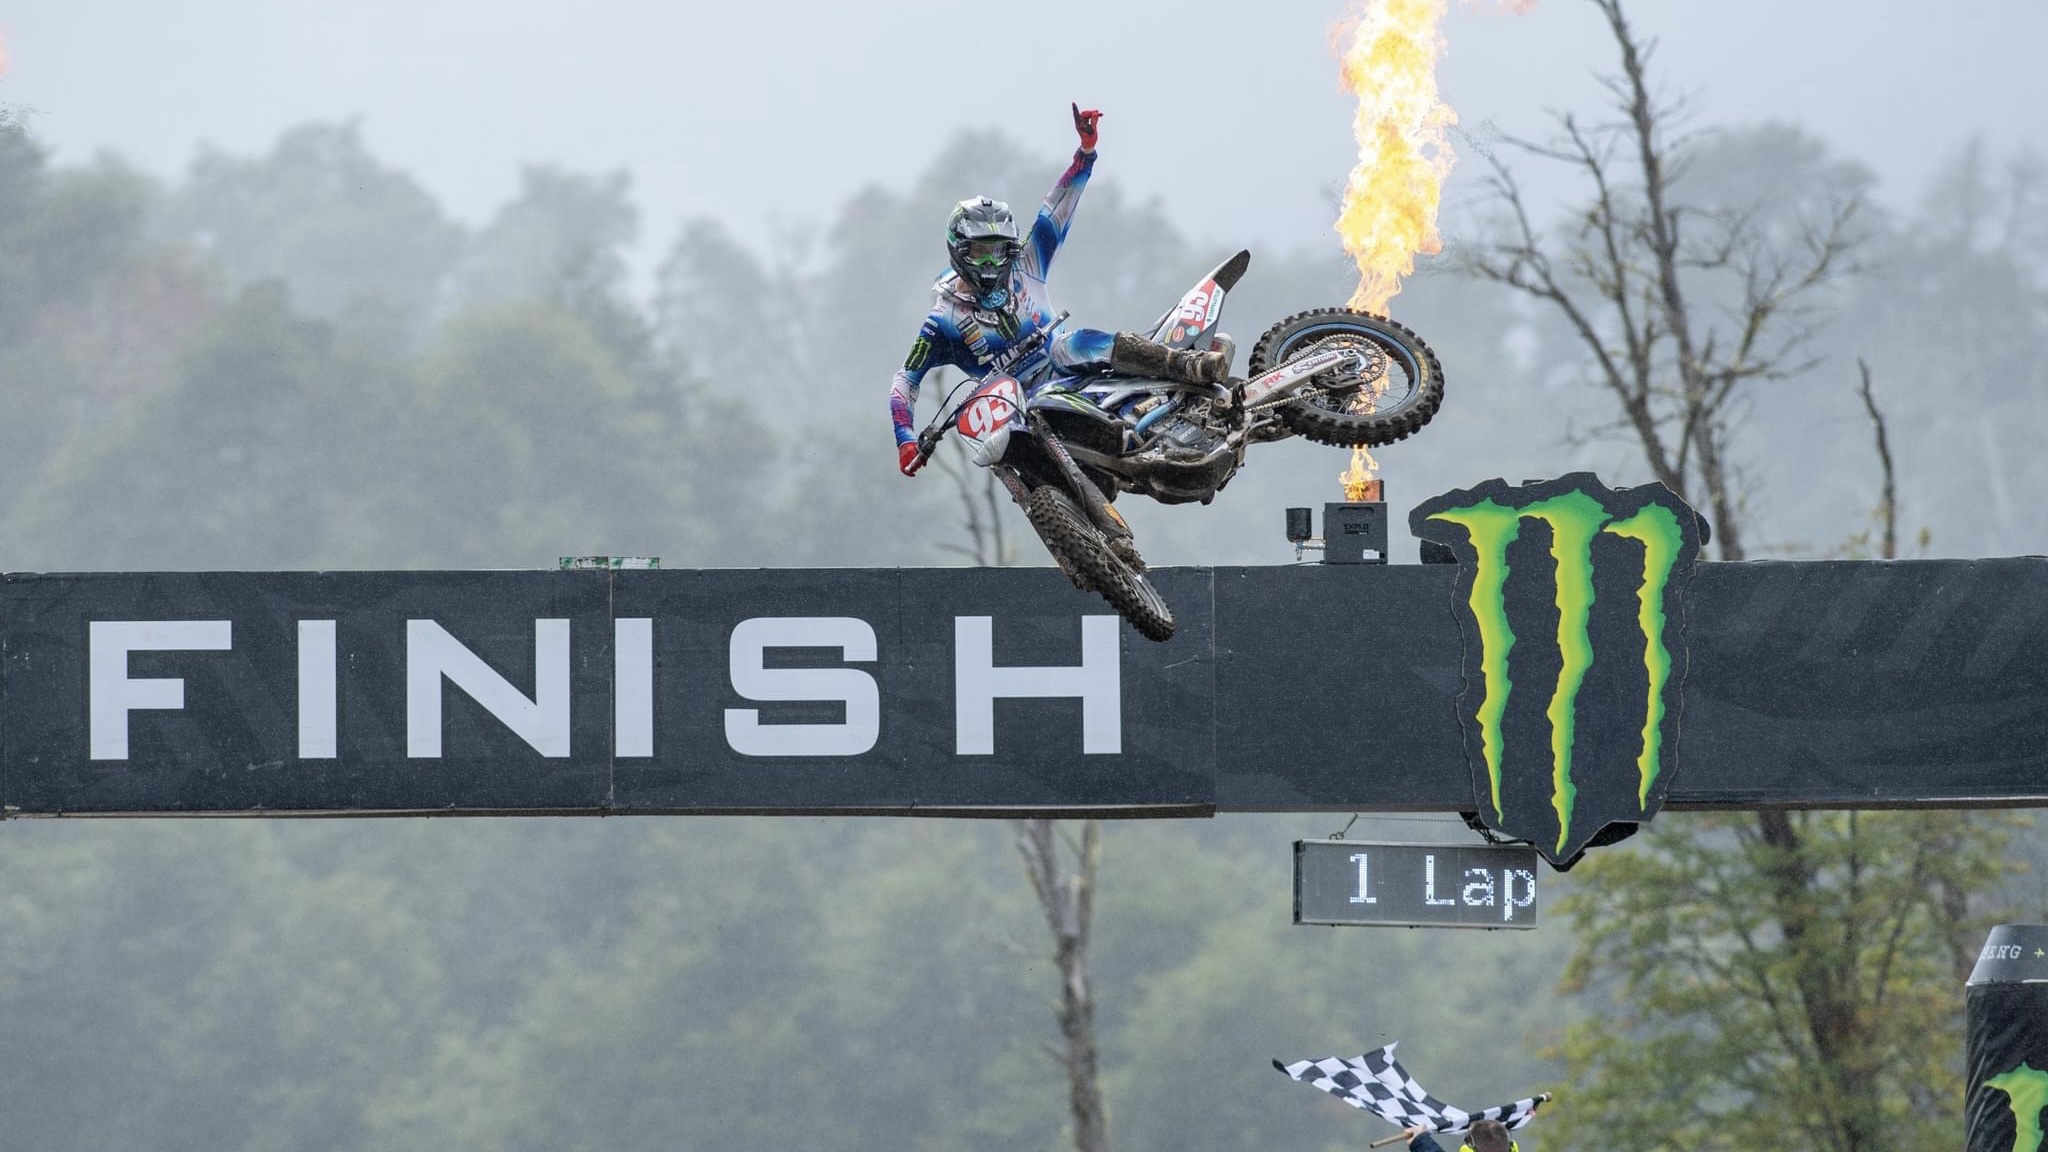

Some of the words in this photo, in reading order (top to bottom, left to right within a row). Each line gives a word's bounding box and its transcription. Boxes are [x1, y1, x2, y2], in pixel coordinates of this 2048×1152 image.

[1180, 291, 1209, 322] 93
[967, 380, 1018, 441] 93
[1262, 371, 1286, 389] RK
[90, 615, 1122, 760] FINISH
[1350, 853, 1377, 904] 1
[1425, 855, 1536, 921] Lap
